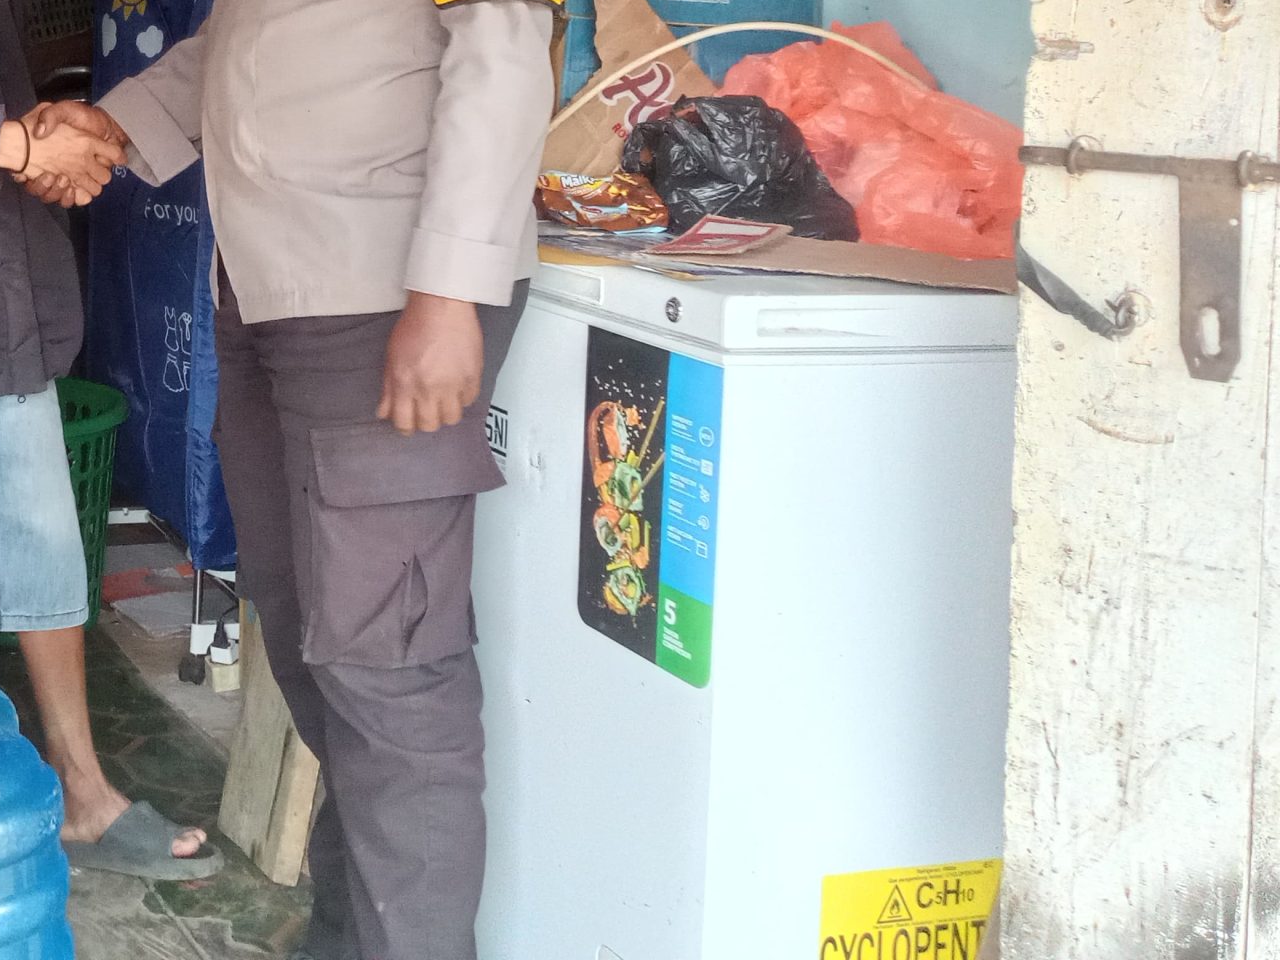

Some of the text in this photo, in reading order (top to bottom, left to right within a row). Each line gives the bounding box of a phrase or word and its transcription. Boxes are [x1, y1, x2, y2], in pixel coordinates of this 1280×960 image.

[561, 175, 596, 188] Malk
[144, 197, 170, 220] For
[663, 597, 677, 626] 5
[820, 920, 988, 960] CYCLOPENT
